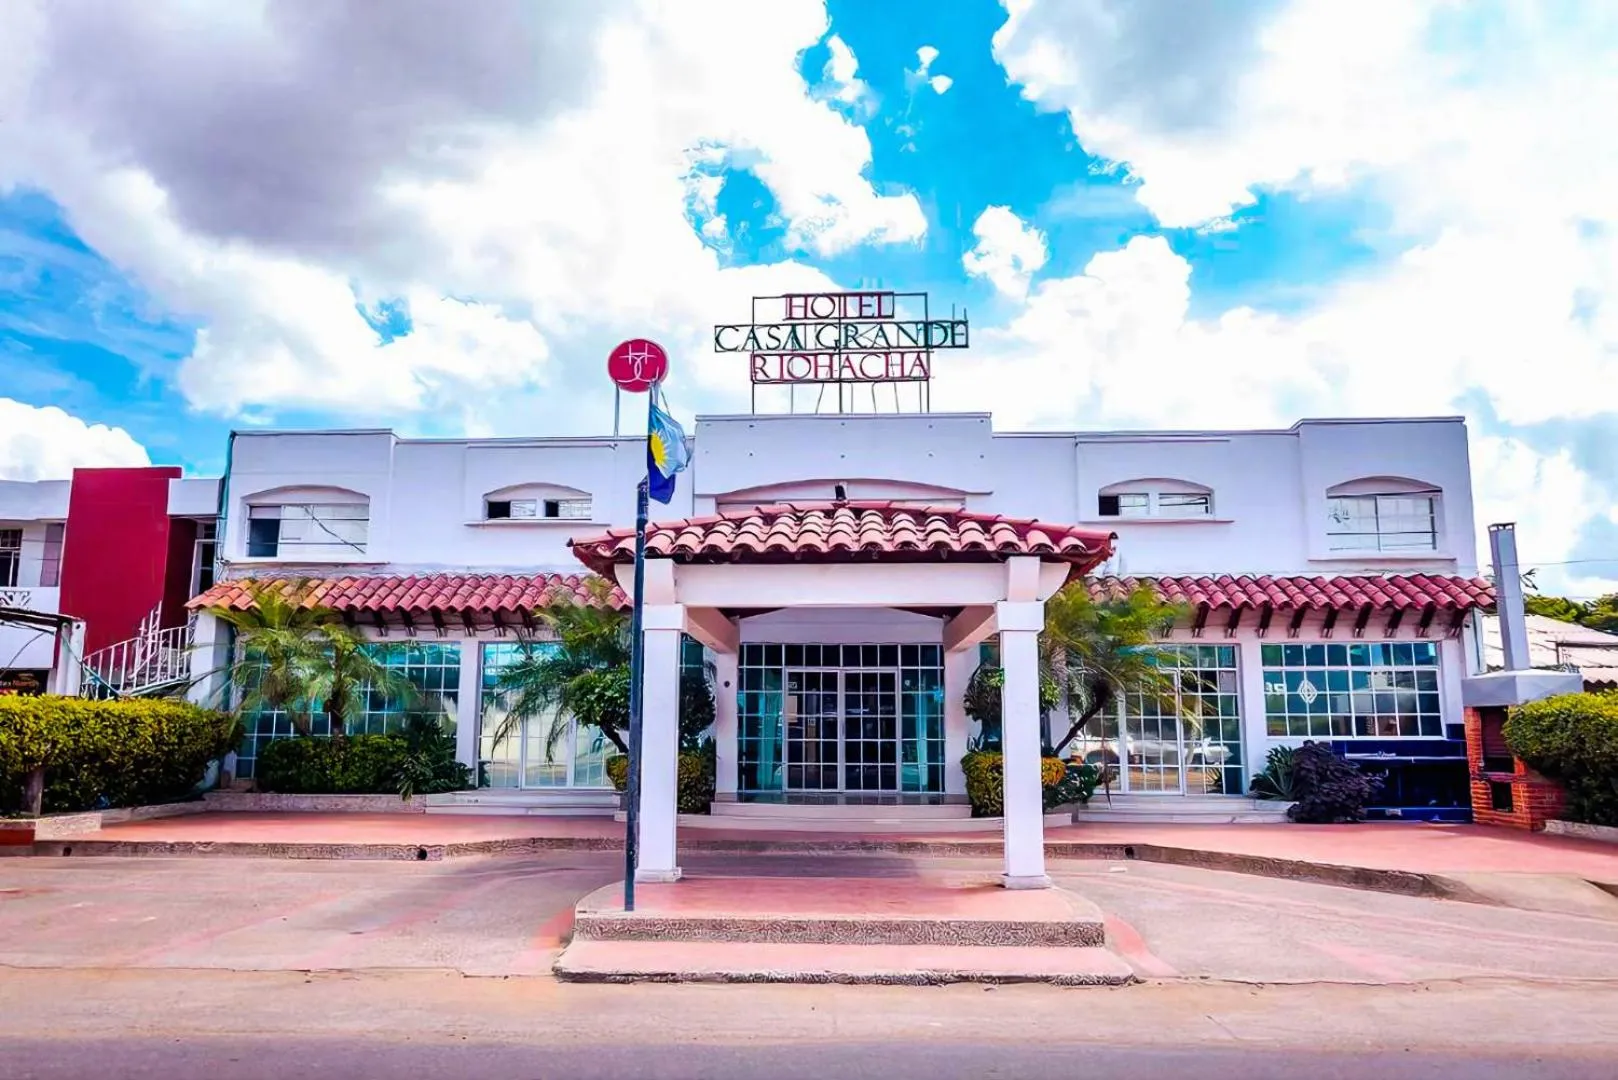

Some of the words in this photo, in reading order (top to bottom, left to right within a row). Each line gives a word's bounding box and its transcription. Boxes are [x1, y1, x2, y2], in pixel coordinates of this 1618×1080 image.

[786, 293, 894, 320] HOTEL
[715, 325, 804, 352] CASA
[815, 321, 968, 350] GRANDE
[751, 353, 929, 381] RIOHACHA
